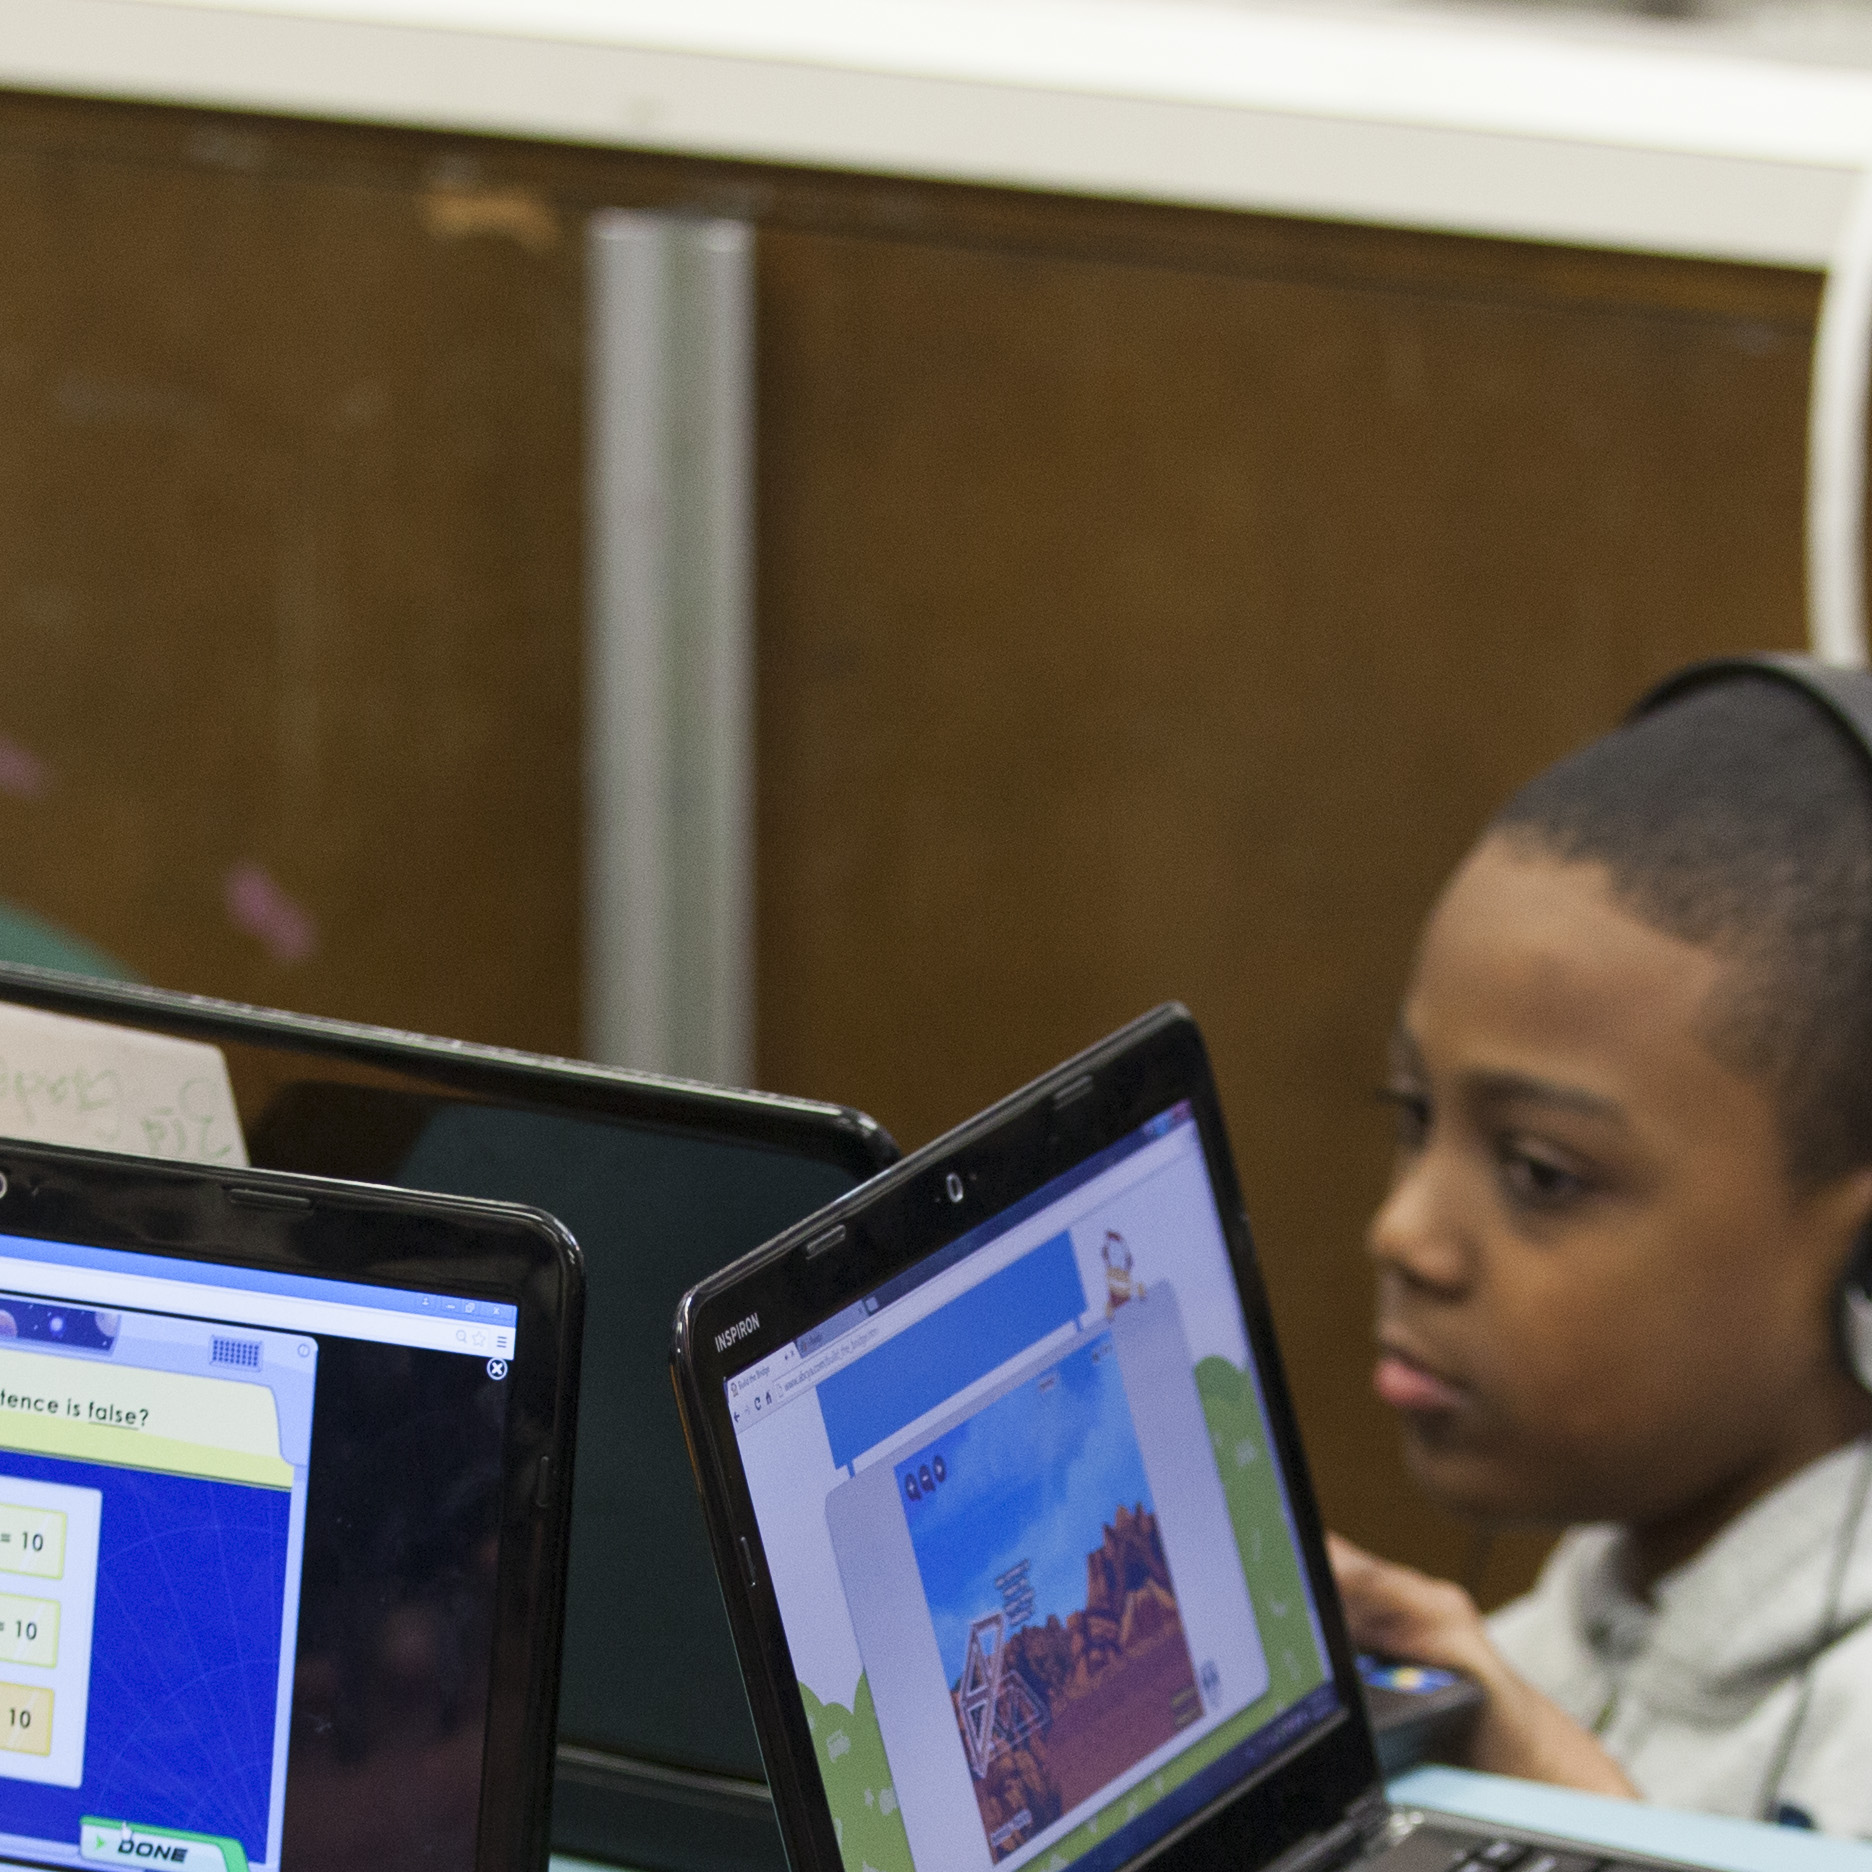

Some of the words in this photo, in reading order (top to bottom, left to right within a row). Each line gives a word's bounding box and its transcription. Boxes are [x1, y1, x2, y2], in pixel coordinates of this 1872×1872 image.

[714, 1312, 761, 1353] INSPIRON
[66, 1398, 81, 1418] is
[88, 1400, 149, 1428] false?
[0, 1533, 11, 1543] =
[22, 1531, 44, 1552] 10
[16, 1620, 37, 1640] 10
[9, 1708, 31, 1729] 10
[117, 1839, 189, 1864] DONE
